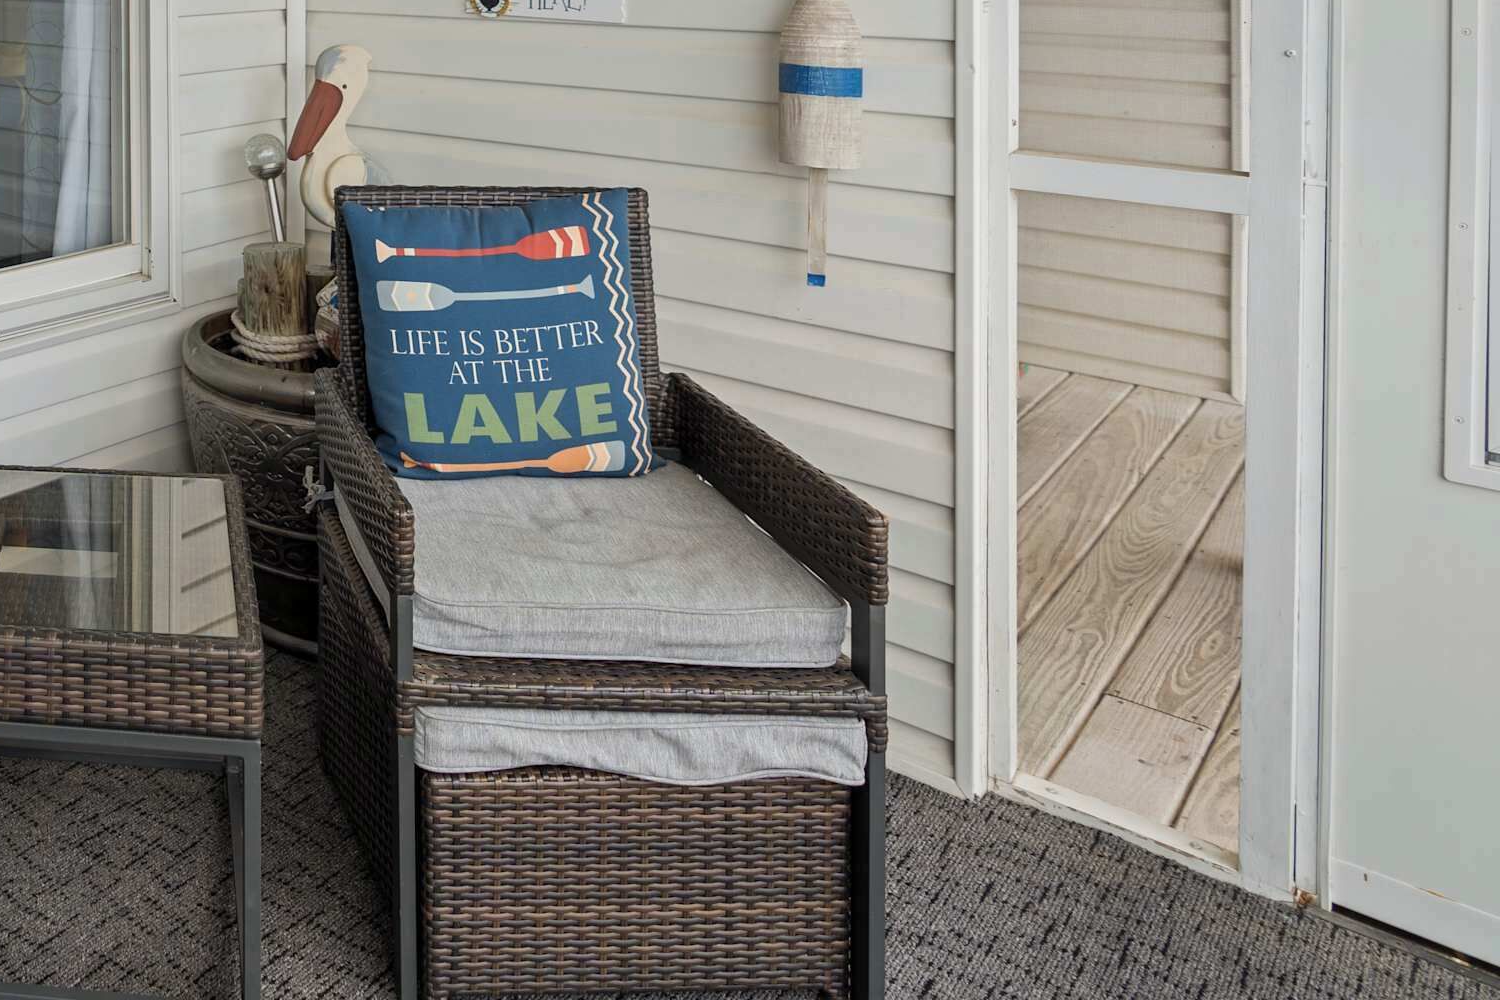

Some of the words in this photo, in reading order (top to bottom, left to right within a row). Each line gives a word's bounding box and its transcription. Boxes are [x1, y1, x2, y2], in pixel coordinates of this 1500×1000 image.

[390, 328, 450, 355] LIFE
[459, 330, 485, 356] IS
[493, 319, 604, 356] BETTER
[449, 360, 484, 385] AT
[493, 357, 552, 384] THE
[404, 382, 617, 445] LAKE
